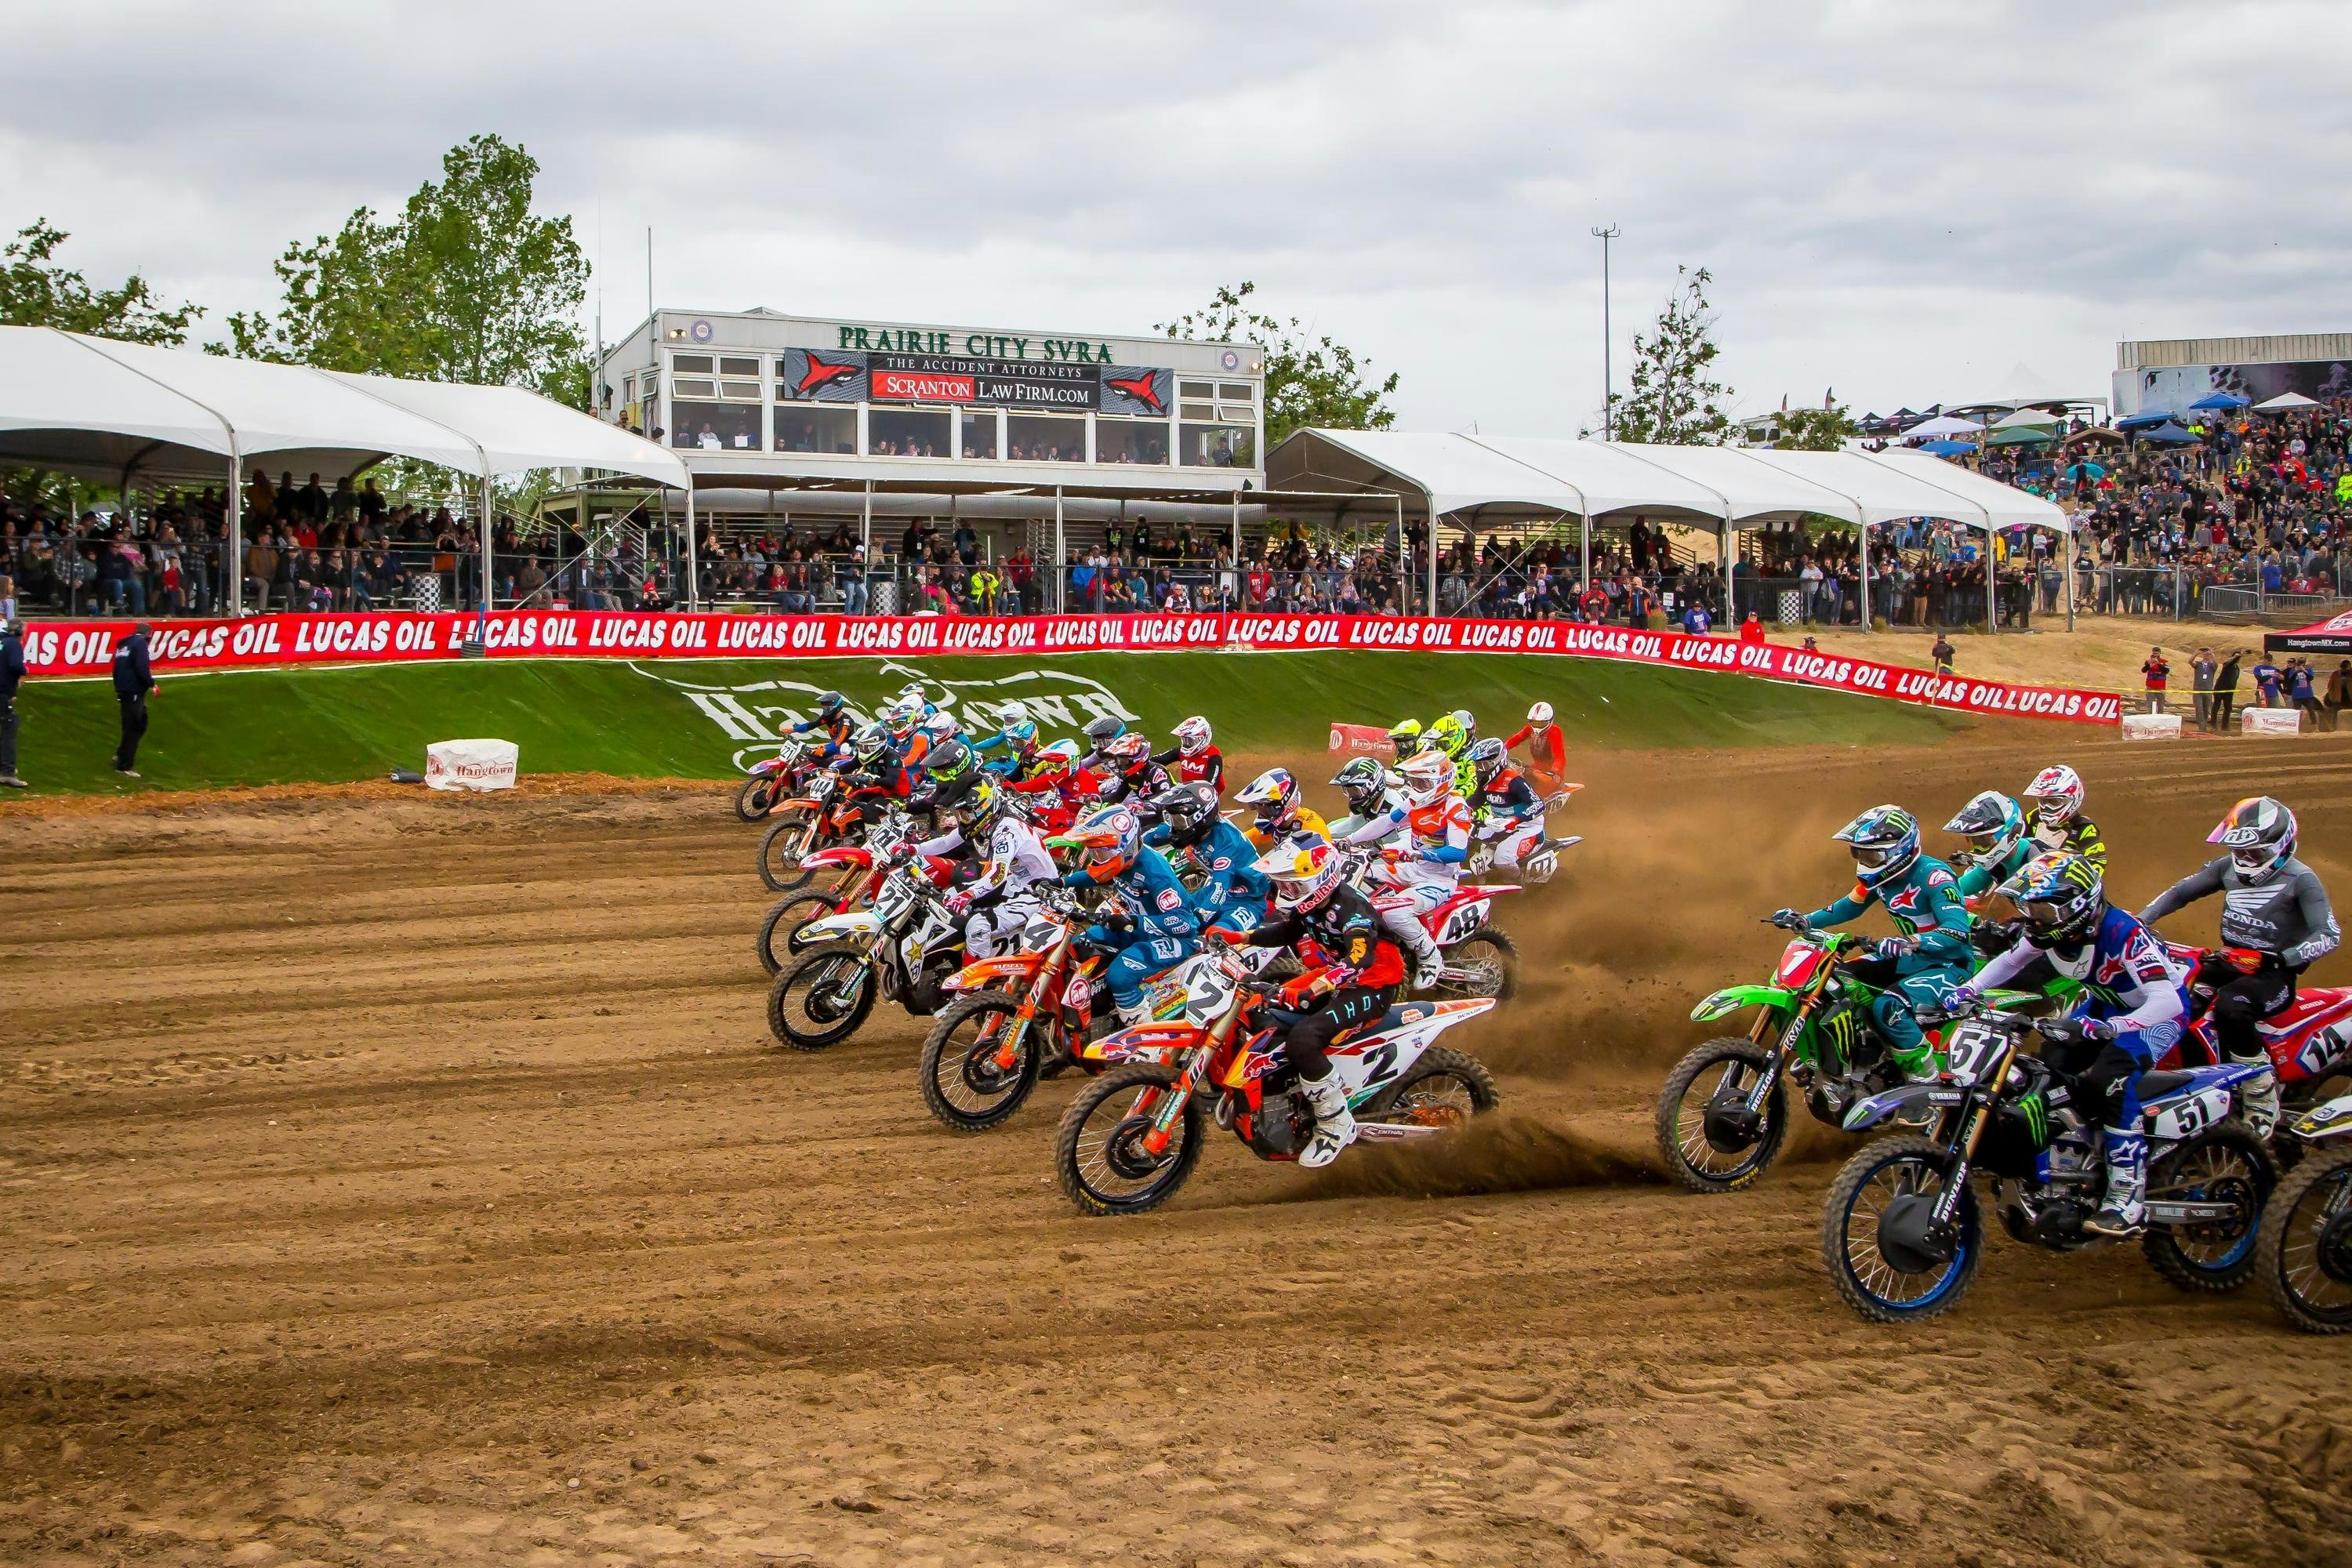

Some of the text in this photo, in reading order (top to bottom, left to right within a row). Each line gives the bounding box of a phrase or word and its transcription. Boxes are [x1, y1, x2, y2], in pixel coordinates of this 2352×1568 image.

[840, 326, 1113, 364] PRAIRIE CITY SVRA
[887, 358, 1082, 378] THE ACCIDENT ATTORNEYS
[887, 376, 971, 398] SCRANTON
[148, 622, 281, 661] UCAS OIL
[294, 620, 436, 652] LUCAS OIL
[542, 618, 578, 647] OIL
[589, 619, 707, 648] LUCAS OIL
[717, 621, 826, 648] LUCAS OIL
[836, 622, 938, 648] LUCAS OIL
[942, 622, 1036, 648] LUCAS OIL
[1044, 620, 1124, 646] LUCAS OIL
[1131, 619, 1218, 644] LUCAS OIL
[1226, 618, 1340, 644] LUCAS OIL
[1349, 621, 1452, 645] LUCAS OIL
[1461, 624, 1556, 648] LUCAS OIL
[1565, 627, 1662, 659] LUCAS OIL
[2287, 639, 2350, 648] HangtownMX.com
[64, 631, 114, 665] OIL
[1670, 638, 1773, 669] LUCAS OIL
[1781, 652, 1888, 690] LUCAS OIL
[1896, 673, 2005, 709] LUCAS OIL
[2003, 690, 2118, 719] LUCAS OIL
[780, 745, 795, 762] 221
[456, 764, 514, 777] Hangtown
[811, 779, 832, 797] 444
[877, 886, 906, 917] 21
[1446, 904, 1480, 942] 48
[2223, 909, 2278, 931] HONDA
[1025, 921, 1058, 951] 4
[1781, 949, 1813, 976] 1
[840, 965, 862, 996] DUNLOP
[1187, 981, 1224, 1022] 2
[1457, 1007, 1483, 1019] DUNLOP
[2299, 1000, 2326, 1011] HONDA
[1362, 1042, 1399, 1088] 2
[1952, 1029, 2006, 1076] 51
[2227, 1068, 2253, 1081] DUNLOP
[1751, 1068, 1775, 1113] DUNLOP
[1166, 1088, 1188, 1123] MOTOREX
[2172, 1096, 2211, 1134] 51
[1940, 1161, 1967, 1222] DUNLOP
